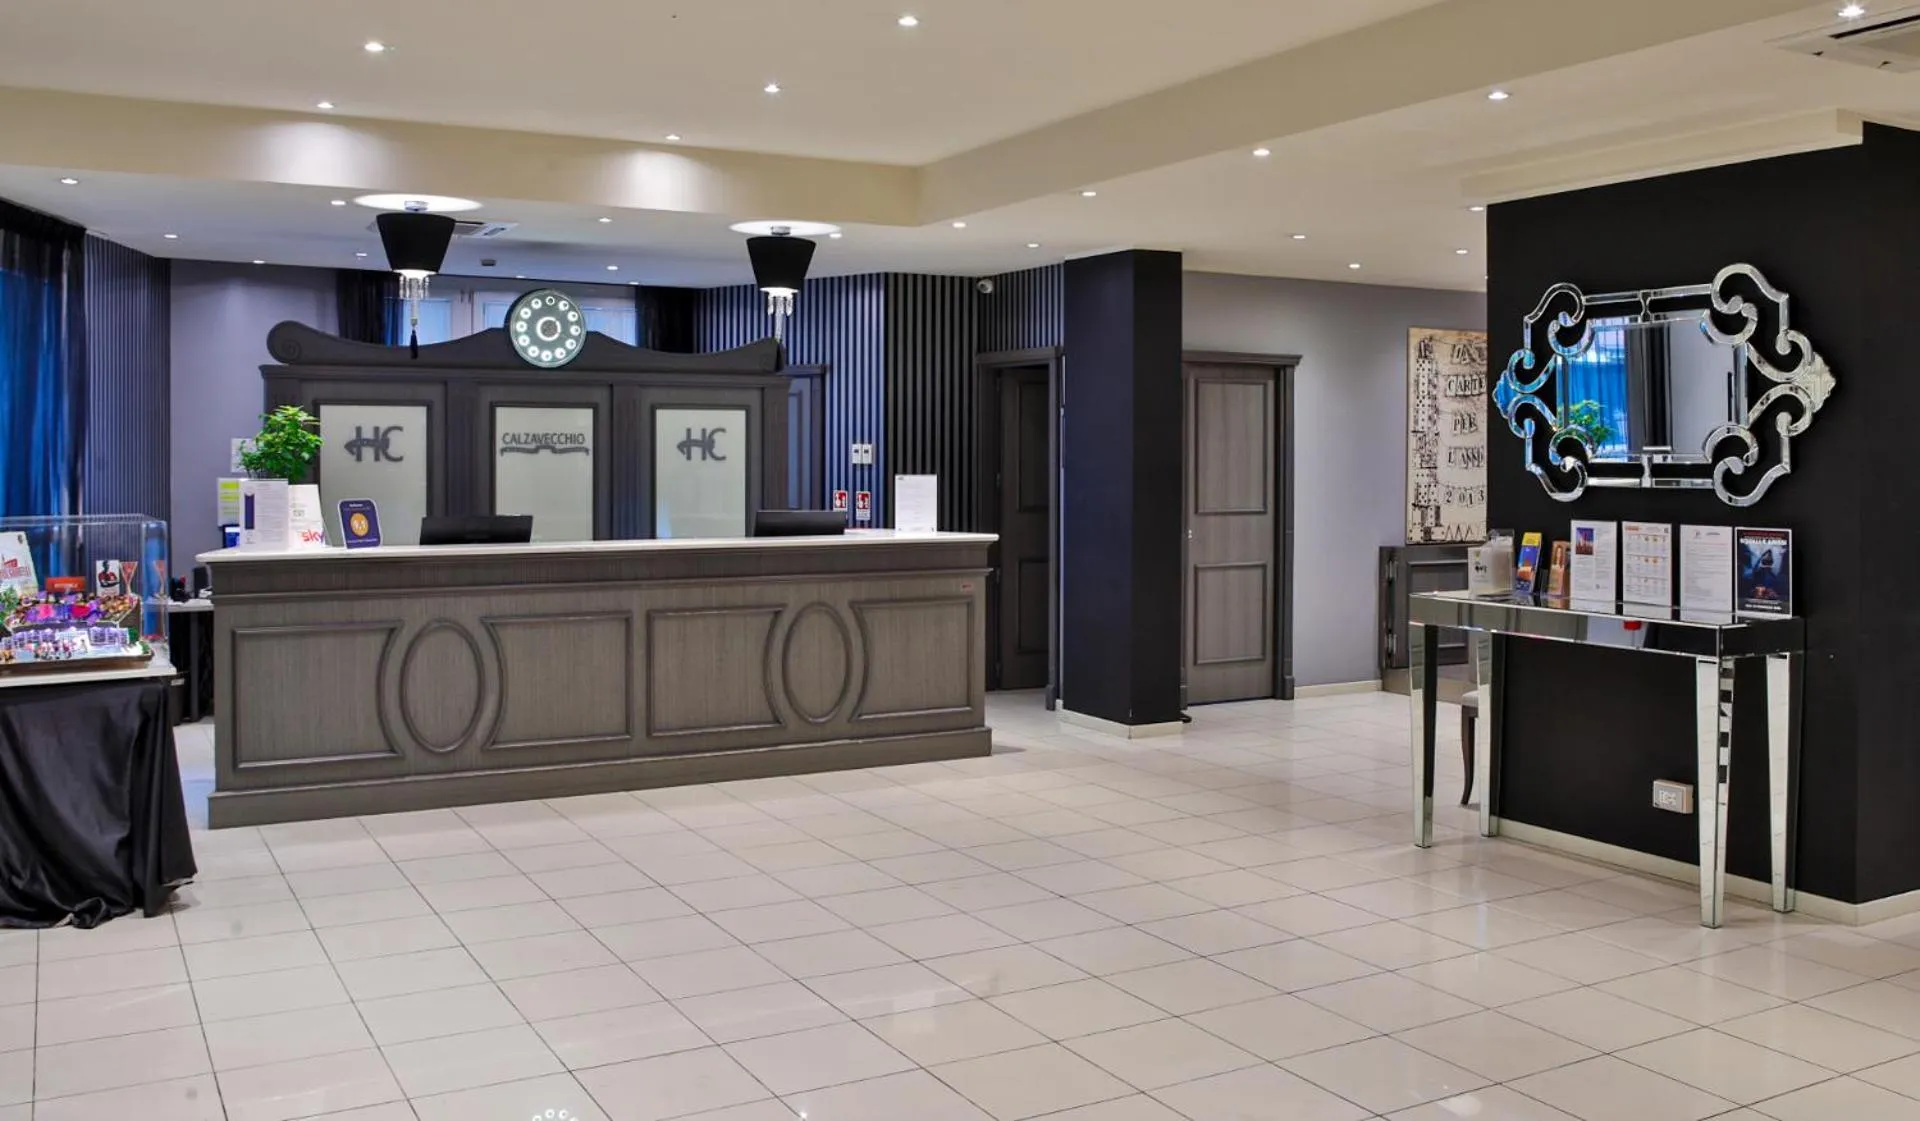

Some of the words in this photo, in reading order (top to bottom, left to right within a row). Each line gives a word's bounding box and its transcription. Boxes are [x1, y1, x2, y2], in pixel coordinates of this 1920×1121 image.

[501, 432, 586, 446] CALZAVECCHIO
[1446, 489, 1486, 505] 2013
[301, 527, 326, 543] sky
